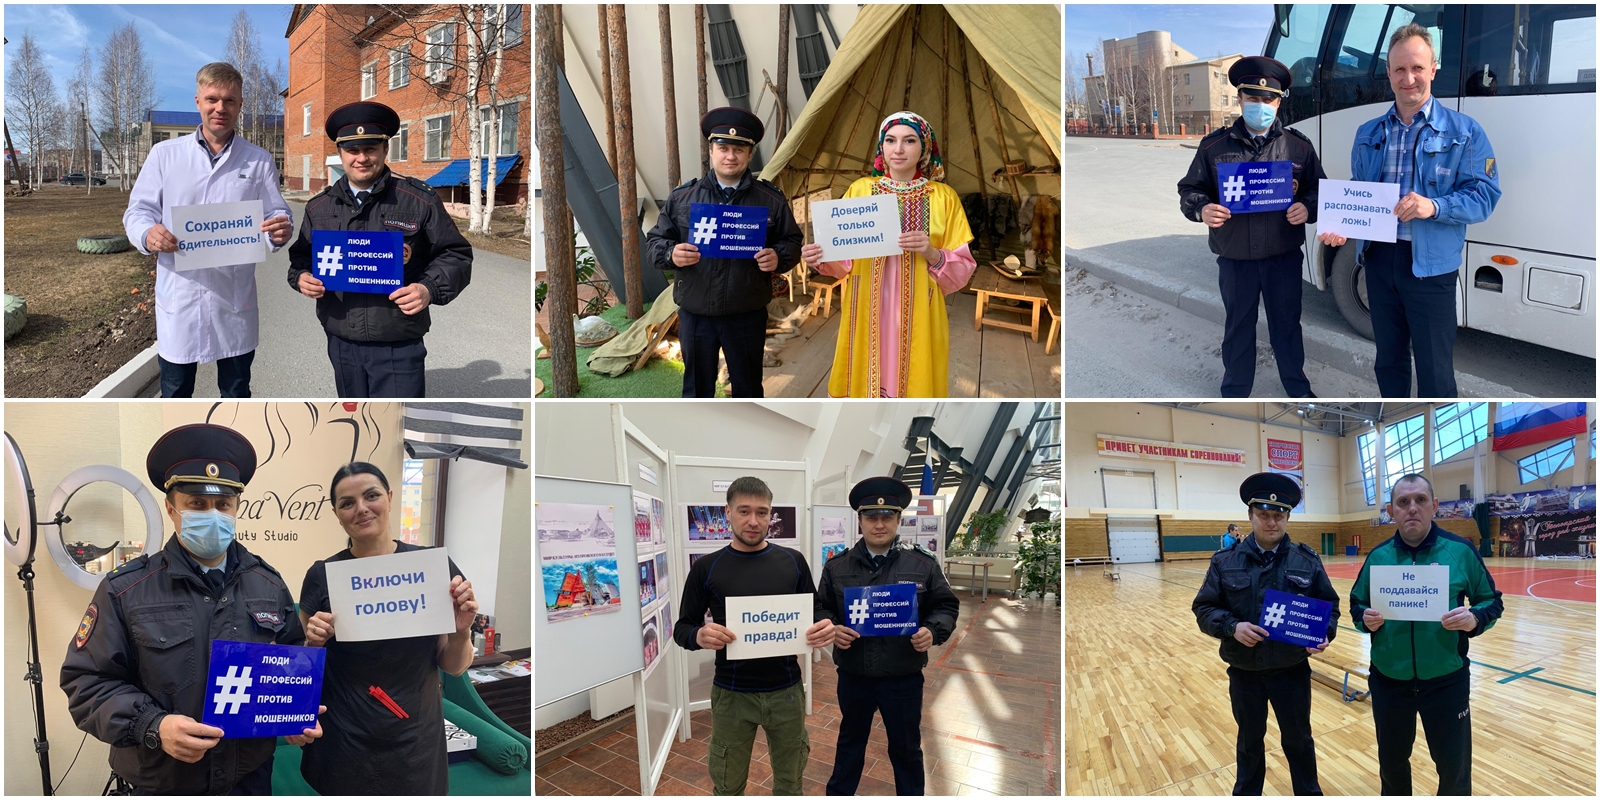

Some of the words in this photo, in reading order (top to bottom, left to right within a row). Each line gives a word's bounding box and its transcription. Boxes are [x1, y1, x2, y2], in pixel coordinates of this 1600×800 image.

[1249, 177, 1286, 185] ПРОФЕССИЙ
[1343, 187, 1373, 198] Учись
[1250, 198, 1292, 206] МОШЕННИКОВ
[831, 202, 879, 218] Доверяй
[1324, 202, 1392, 215] распознавать
[185, 215, 253, 233] Сохраняй
[721, 222, 760, 230] ПРОФЕССИЙ
[837, 220, 875, 231] только
[1341, 217, 1372, 227] ложь!
[178, 233, 261, 251] бдительность!
[347, 238, 371, 246] ЛЮДИ
[832, 232, 884, 247] близким!
[347, 251, 394, 259] ПРОФЕССИЙ
[348, 264, 378, 272] ПРОТИВ
[348, 277, 401, 286] МОШЕННИКОВ
[1105, 440, 1136, 453] ПРИВЕТ
[1138, 444, 1188, 458] УЧАСТНИКАМ
[1271, 448, 1298, 459] СПОРТ
[263, 484, 331, 521] Vent
[264, 529, 299, 541] Studio
[351, 571, 425, 591] Включи
[1402, 572, 1416, 581] Не
[1379, 585, 1439, 596] поддавайся
[355, 593, 426, 616] голову!
[872, 600, 910, 608] ПРОФЕССИЙ
[1291, 600, 1309, 609] ЛЮДИ
[1388, 599, 1428, 608] панике!
[742, 610, 801, 624] Победит
[1289, 610, 1323, 622] ПРОФЕССИЙ
[1287, 620, 1309, 630] ПРОТИВ
[744, 627, 797, 645] правда!
[1284, 630, 1324, 643] МОШЕННИКОВ
[261, 655, 290, 666] ЛЮДИ
[259, 675, 313, 685] ПРОФЕССИЙ
[257, 695, 293, 704] ПРОТИВ
[254, 714, 316, 723] МОШЕННИКОВ
